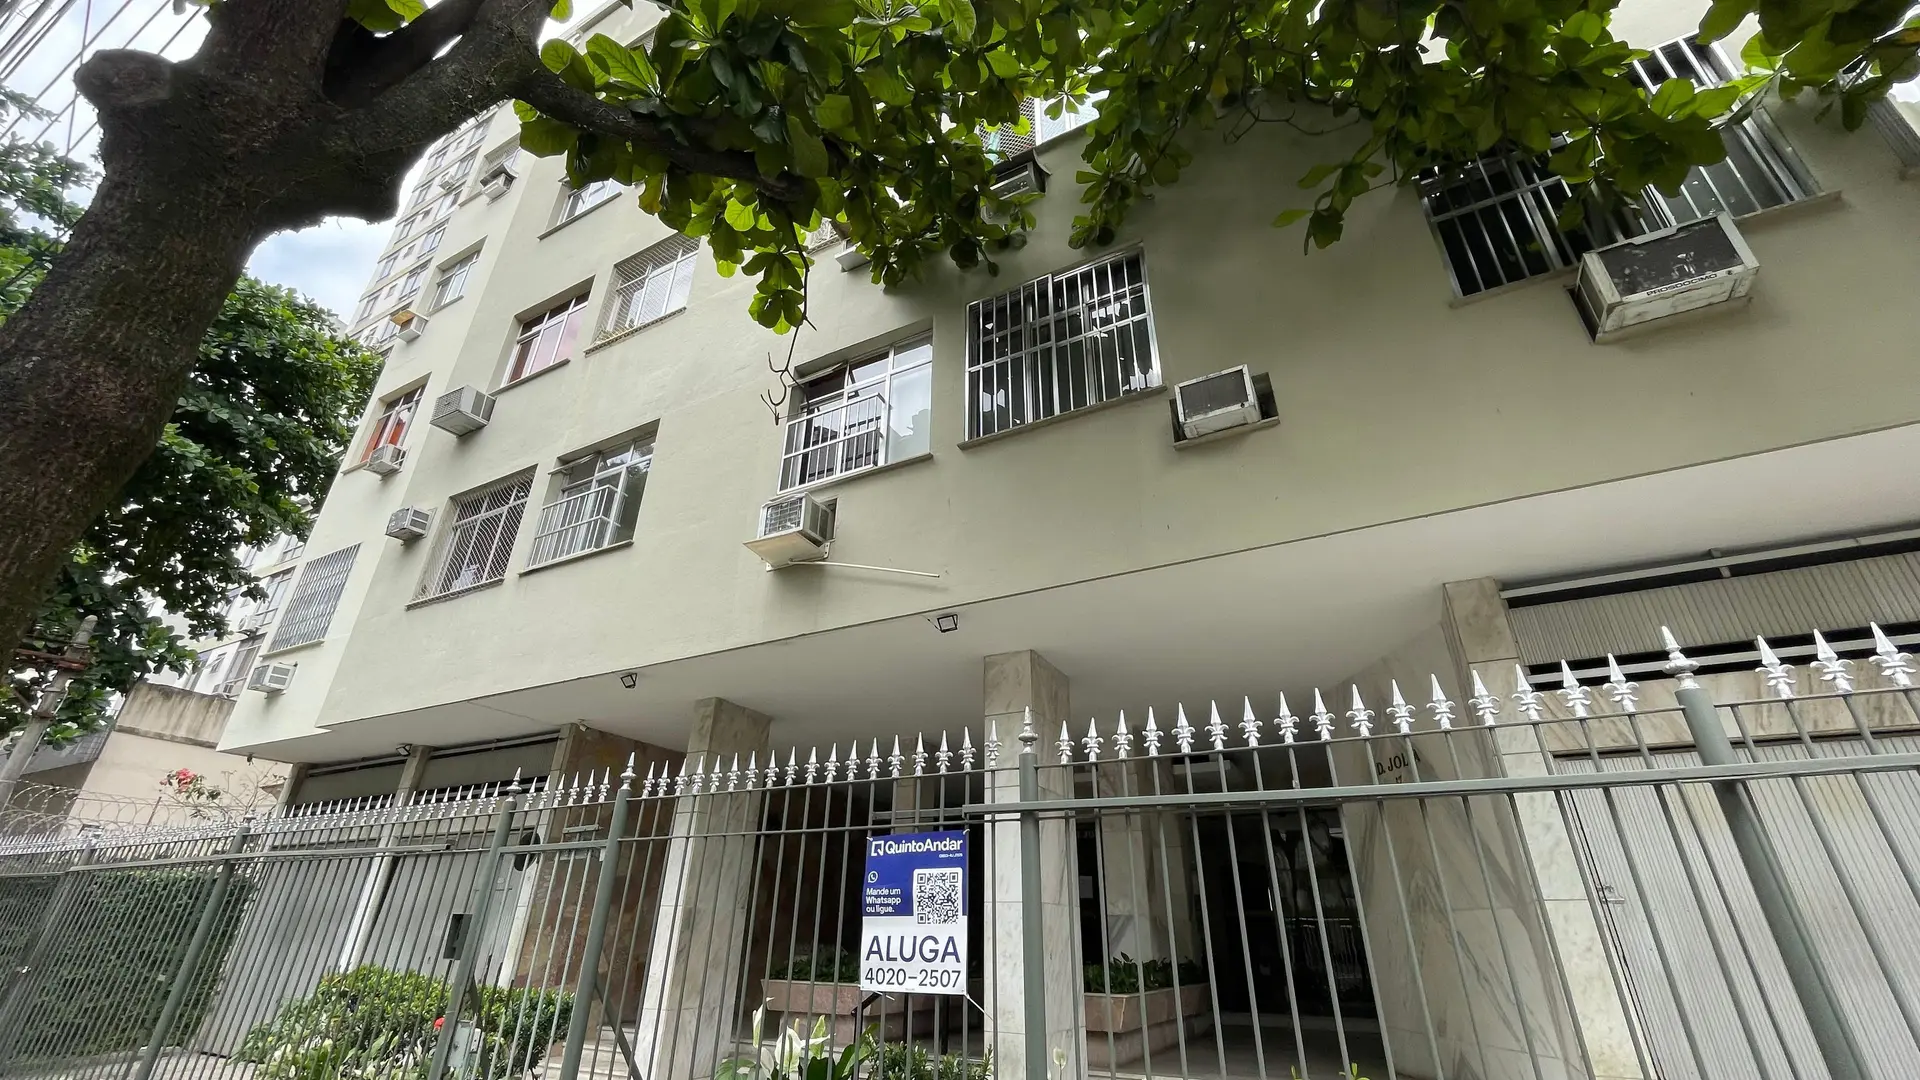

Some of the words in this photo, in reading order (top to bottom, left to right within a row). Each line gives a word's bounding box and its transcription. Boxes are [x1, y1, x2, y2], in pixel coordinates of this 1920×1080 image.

[1646, 273, 1717, 296] PROSDOCIMO
[1387, 749, 1421, 771] JOLA
[885, 837, 963, 855] QuintoAndar
[866, 887, 889, 896] Mande
[866, 896, 901, 906] Whatsapp
[876, 904, 895, 915] ligue.
[865, 935, 961, 963] ALUGA
[864, 967, 961, 988] 4020-2507
